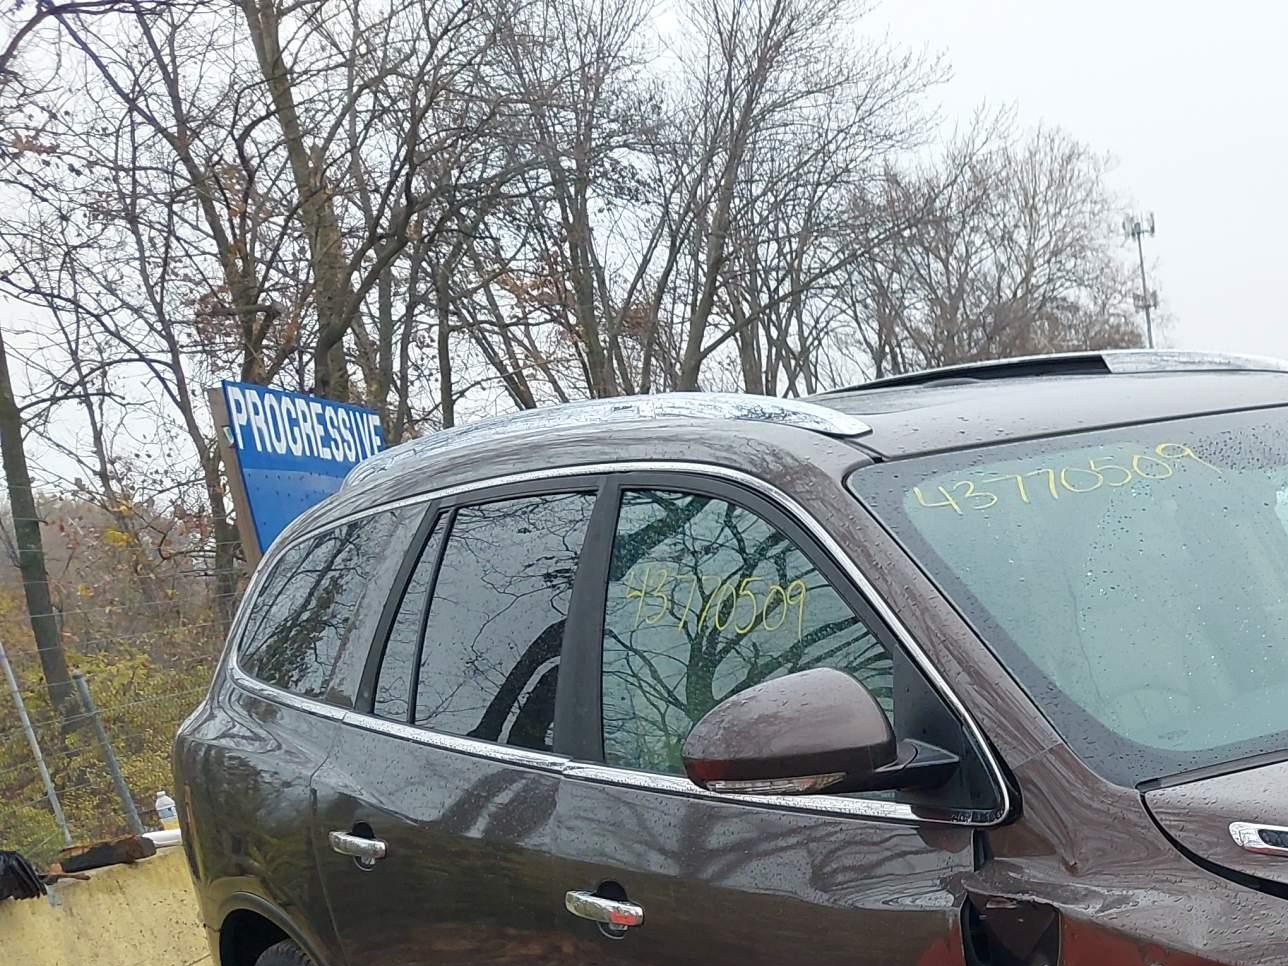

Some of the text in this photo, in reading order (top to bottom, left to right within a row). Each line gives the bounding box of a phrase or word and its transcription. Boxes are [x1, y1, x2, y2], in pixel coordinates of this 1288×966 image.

[227, 386, 382, 463] PROGRESSIVE
[912, 443, 1223, 514] 43770509
[626, 568, 807, 641] 43770509
